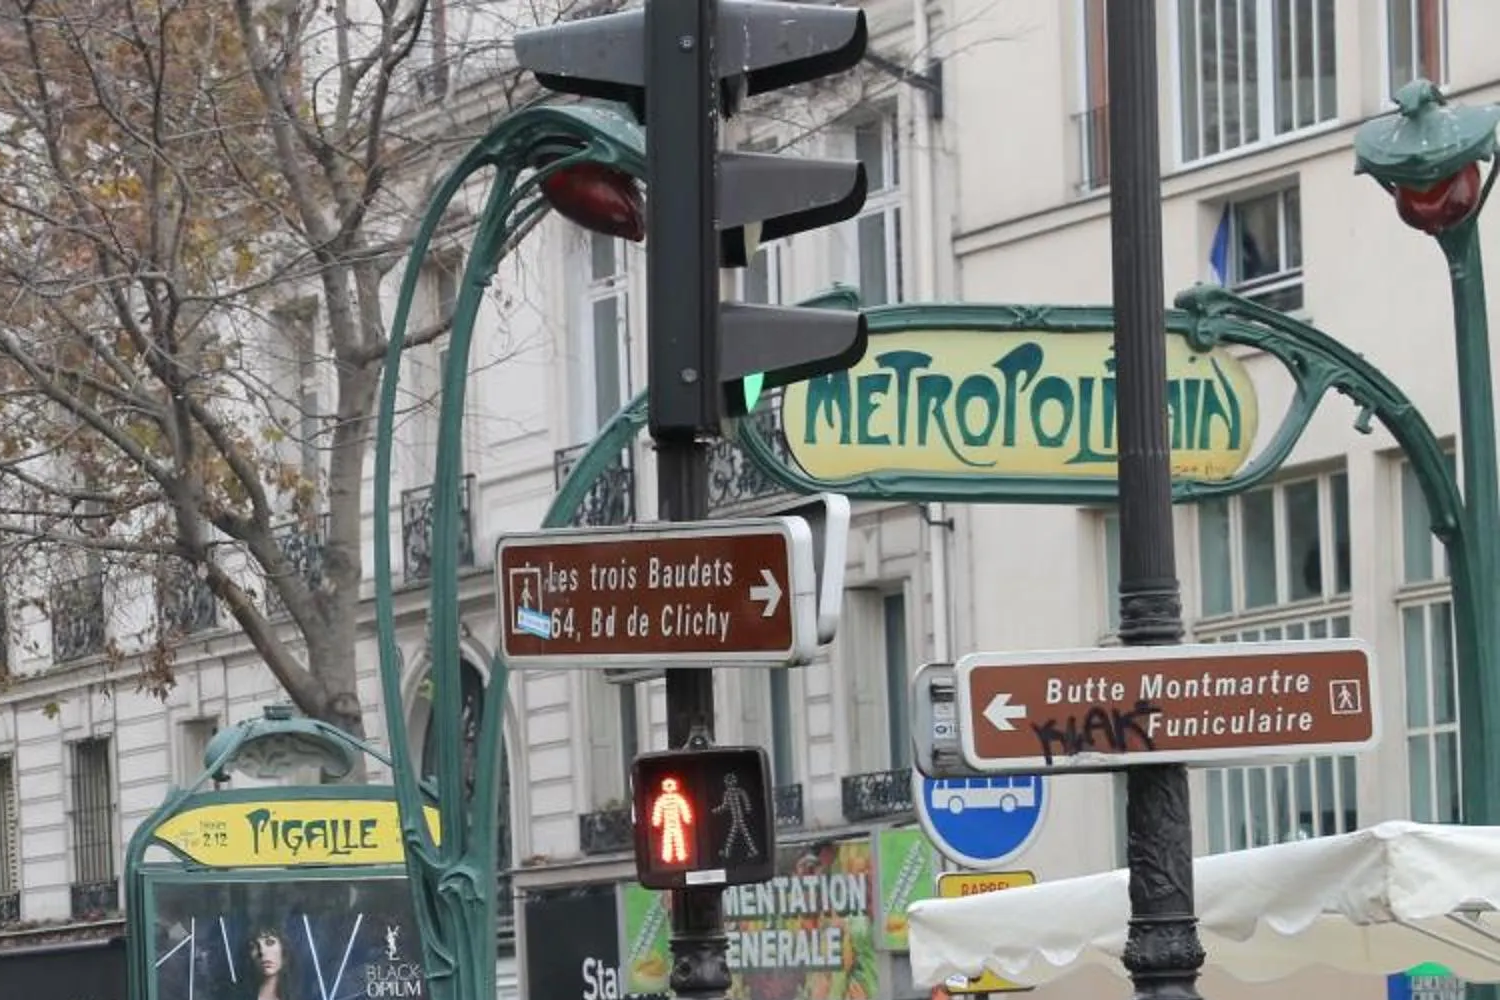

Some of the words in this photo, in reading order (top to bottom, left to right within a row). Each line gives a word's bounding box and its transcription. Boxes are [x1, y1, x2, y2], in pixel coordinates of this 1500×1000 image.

[548, 561, 579, 593] Les
[590, 559, 637, 591] trois
[648, 555, 734, 588] Baudets
[551, 607, 582, 642] 64,
[591, 606, 617, 637] Bd
[627, 604, 650, 636] de
[660, 603, 730, 642] Clichy
[1046, 676, 1125, 704] Butte
[1140, 669, 1311, 699] Montmartre
[1147, 706, 1313, 738] Funiculaire
[245, 808, 378, 856] PIGALLE
[366, 964, 422, 982] BLACK
[367, 980, 421, 997] OPIUM
